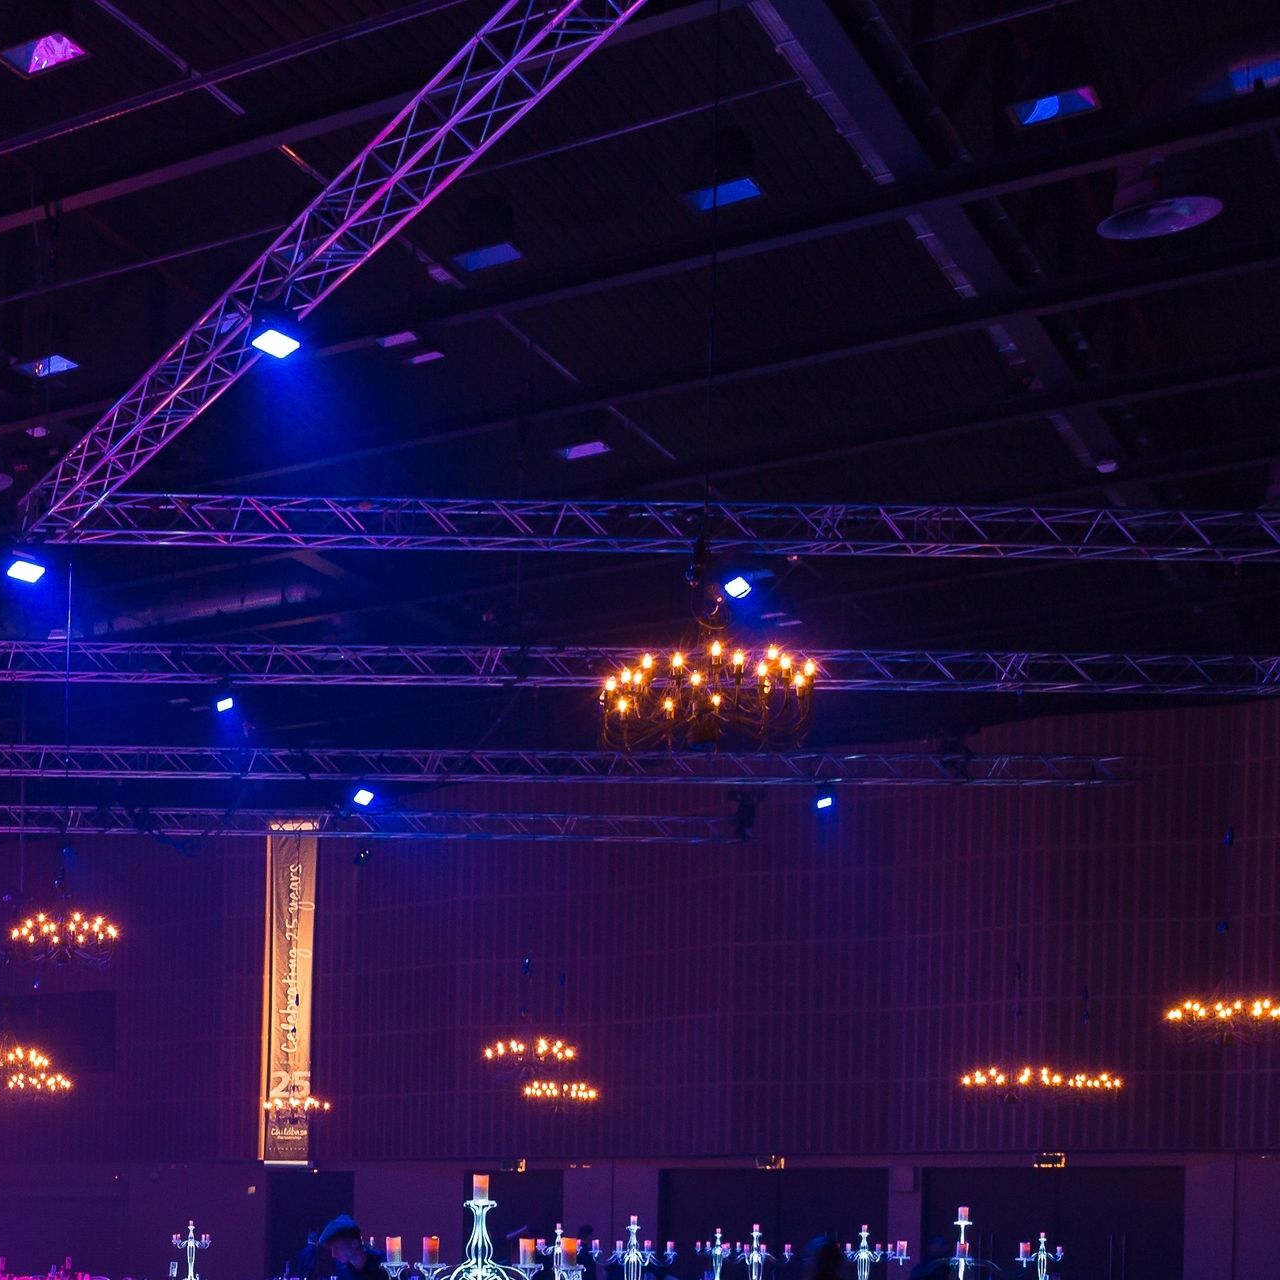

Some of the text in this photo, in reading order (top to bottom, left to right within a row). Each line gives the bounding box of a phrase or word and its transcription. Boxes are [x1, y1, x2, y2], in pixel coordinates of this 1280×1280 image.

[288, 864, 315, 913] years
[285, 919, 300, 941] 25
[269, 1071, 311, 1098] 25
